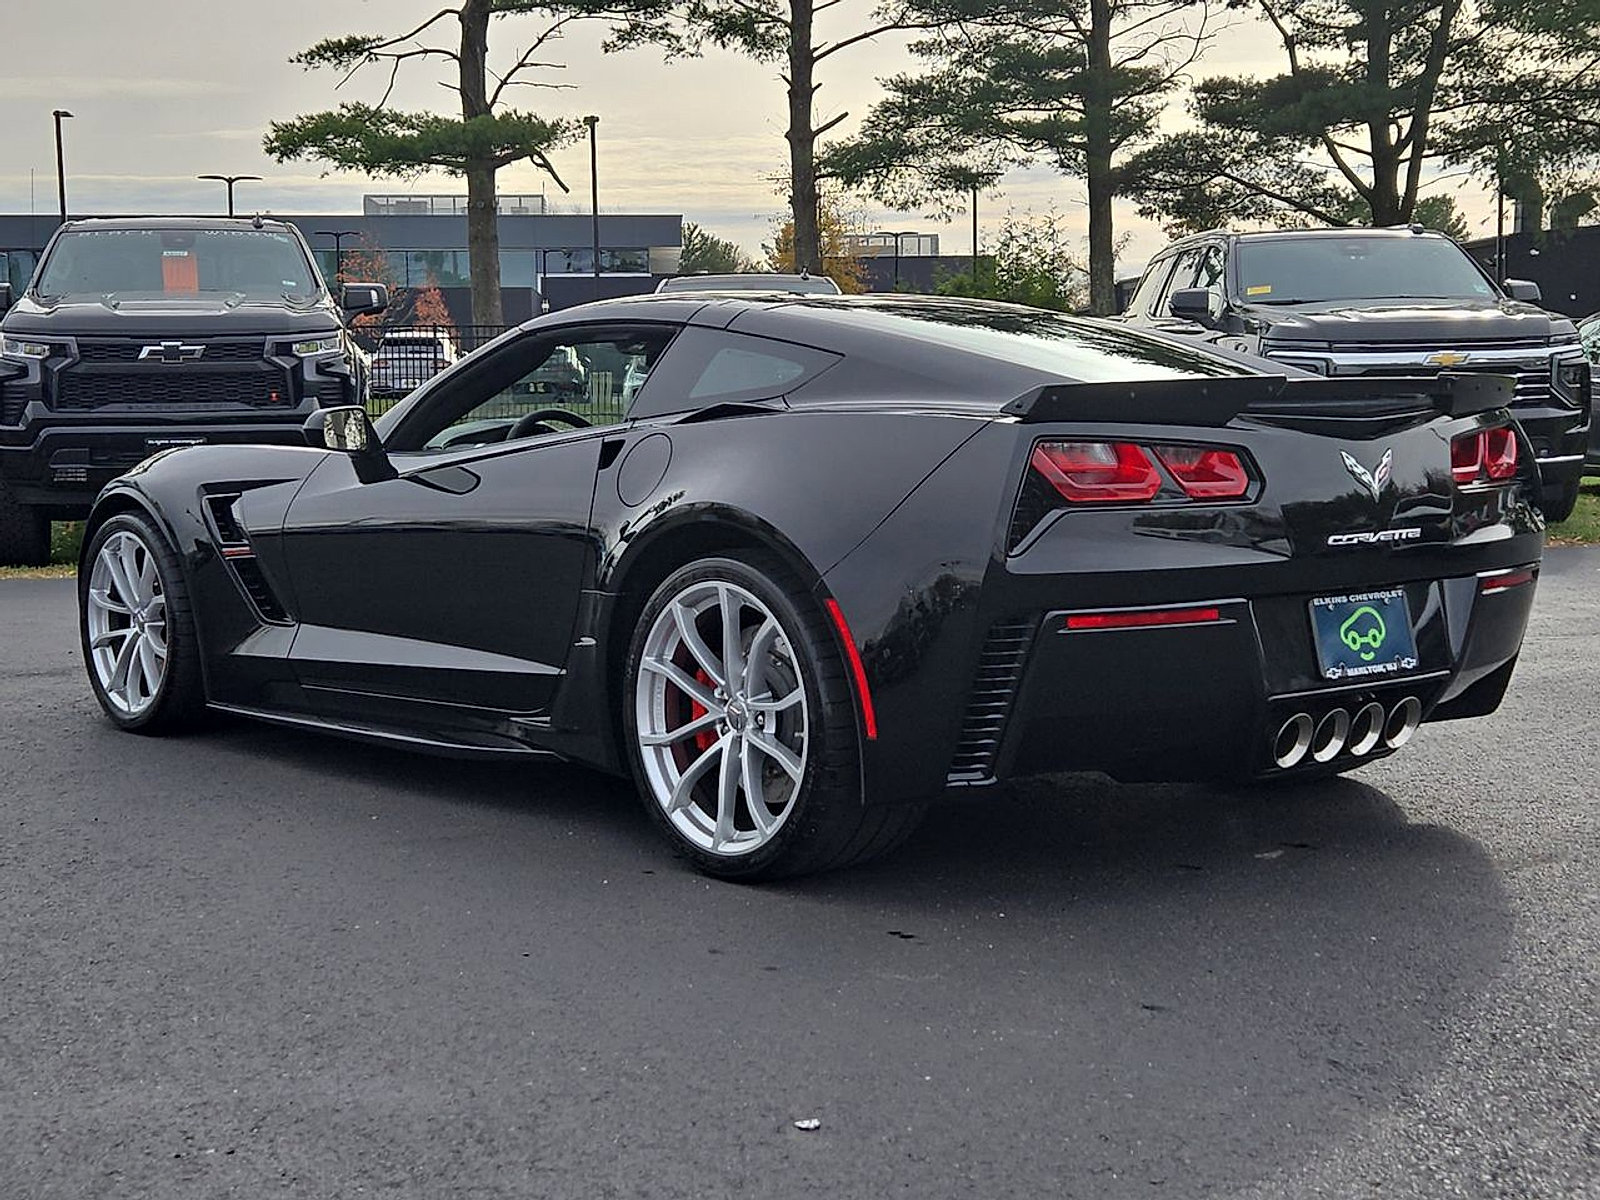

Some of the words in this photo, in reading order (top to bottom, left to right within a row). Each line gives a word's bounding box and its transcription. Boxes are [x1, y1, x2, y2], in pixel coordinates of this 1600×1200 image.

[1328, 528, 1421, 545] CORVETTE
[1313, 595, 1348, 606] ELKINS
[1349, 589, 1403, 602] CHEVROLET
